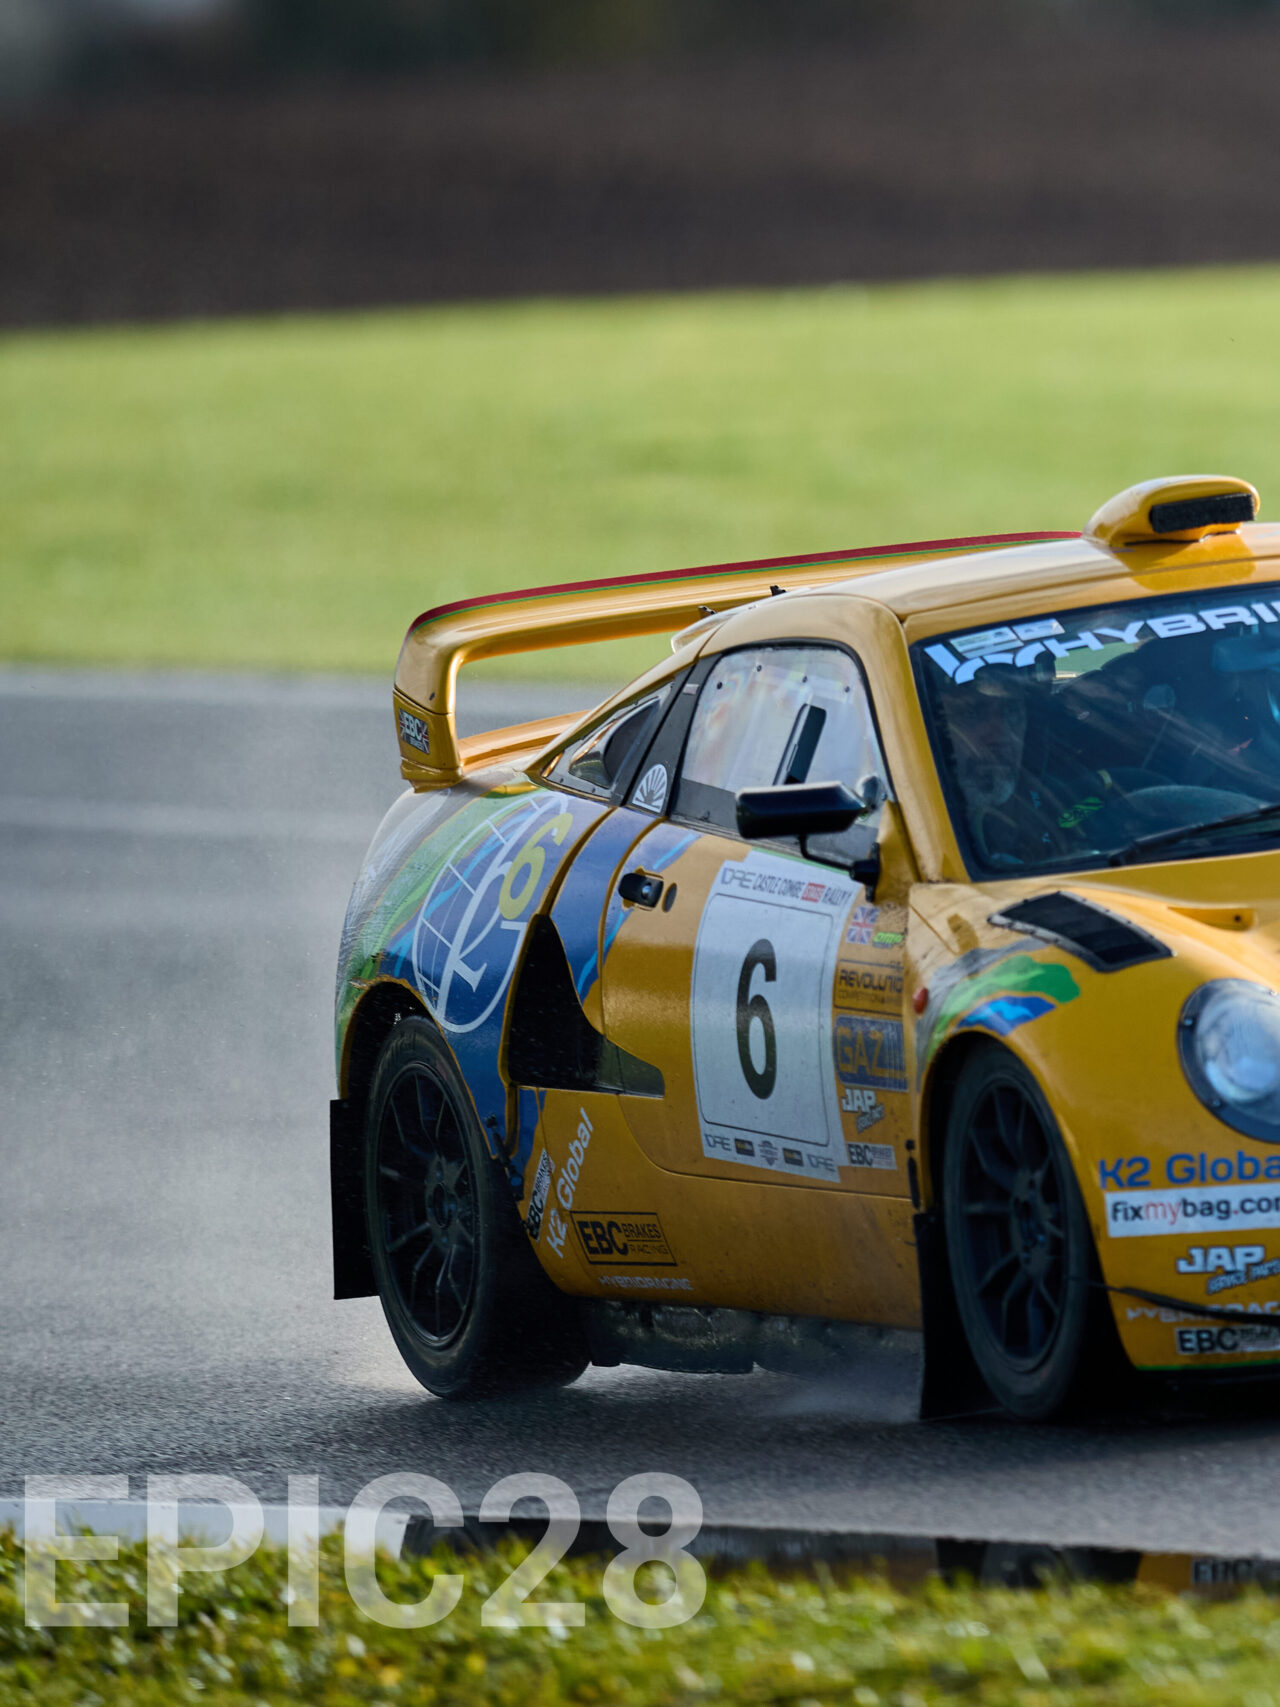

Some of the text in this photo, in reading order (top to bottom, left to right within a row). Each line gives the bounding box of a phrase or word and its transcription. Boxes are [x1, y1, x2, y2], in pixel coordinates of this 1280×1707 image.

[402, 710, 423, 741] EBC
[736, 938, 777, 1100] 6
[837, 1026, 907, 1079] GAZ
[841, 1088, 877, 1114] JAP
[556, 1107, 594, 1210] Global
[847, 1143, 873, 1167] EBC
[1098, 1156, 1151, 1189] K2
[546, 1207, 568, 1259] K2
[577, 1220, 662, 1256] EBC BRAKES
[1176, 1245, 1266, 1274] JAP
[1178, 1329, 1240, 1351] EBC
